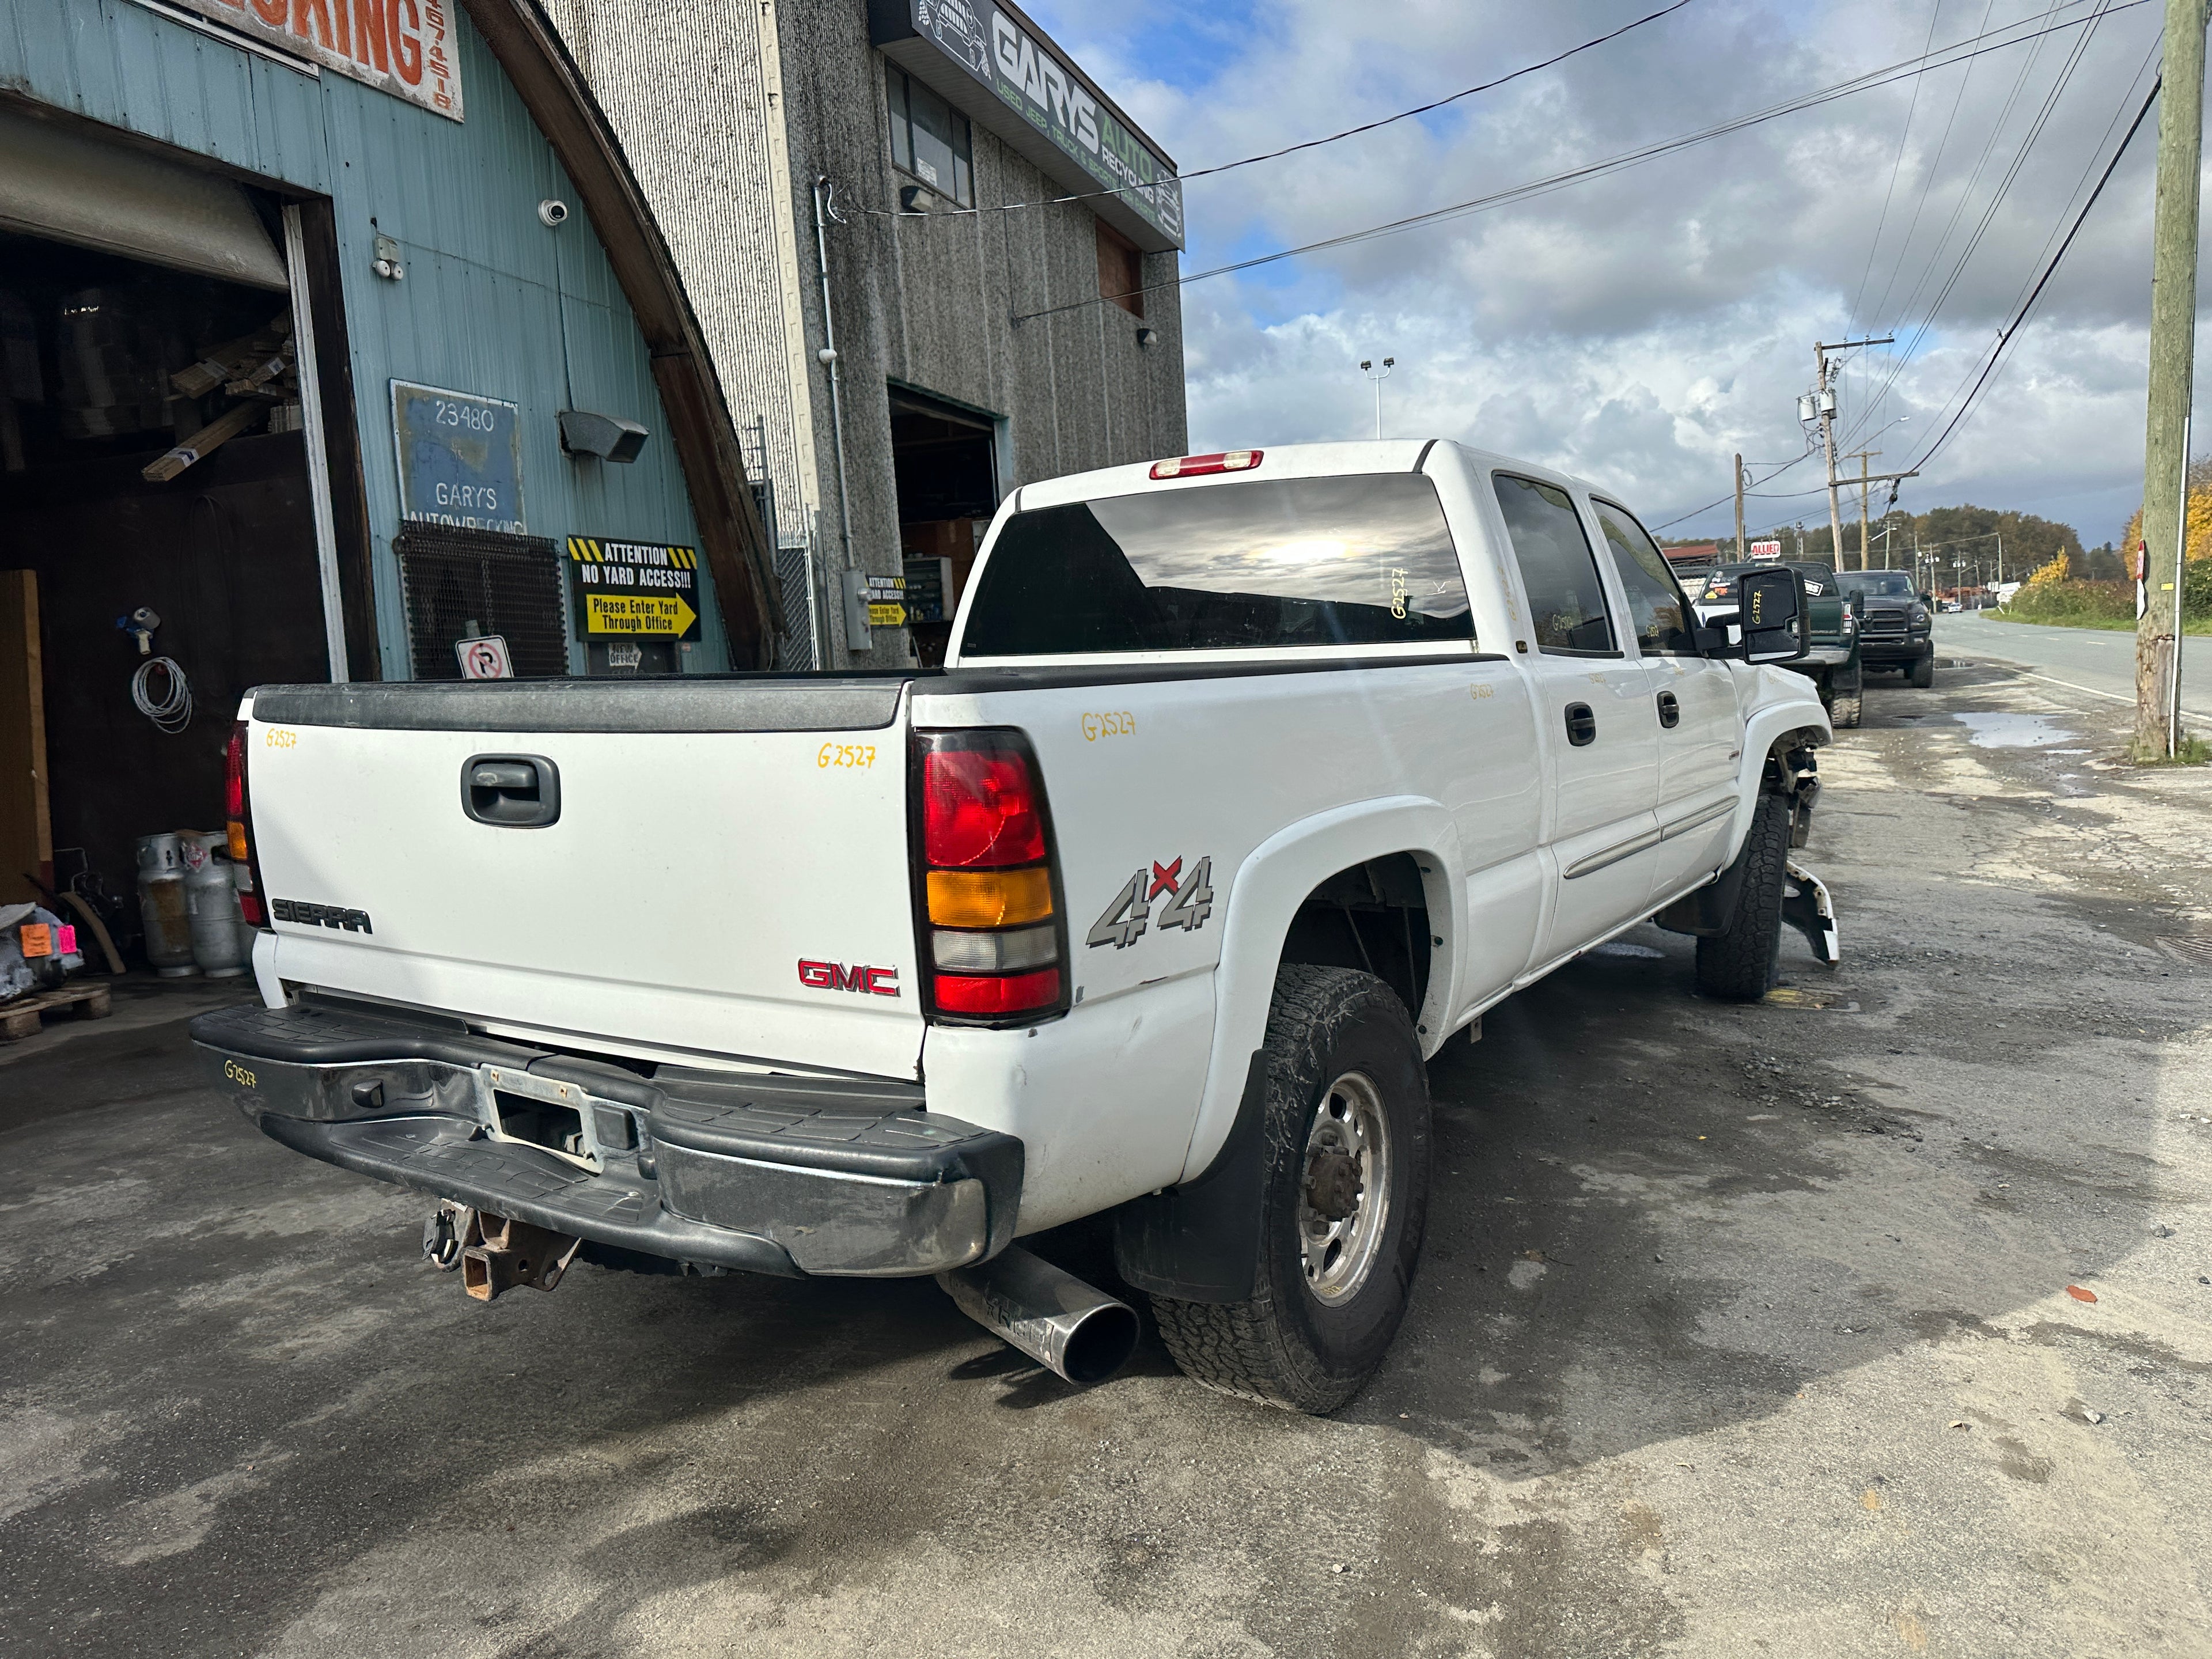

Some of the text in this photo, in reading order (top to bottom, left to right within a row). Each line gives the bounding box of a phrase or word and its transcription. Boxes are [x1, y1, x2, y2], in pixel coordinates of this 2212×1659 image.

[992, 10, 1099, 154] GARYS
[996, 78, 1023, 111] USED
[1051, 124, 1079, 158] TRUCK
[1101, 115, 1152, 184] AUTO
[1101, 145, 1154, 204] RECYCLING
[436, 400, 494, 432] 23480
[436, 482, 497, 510] GARY'S
[605, 543, 668, 566] ATTENTION
[1752, 544, 1779, 554] ALLIED
[581, 564, 691, 589] NO YARD ACCESS!!!
[869, 577, 895, 588] ATTENTION
[593, 598, 679, 615] Please Enter Yard
[1391, 568, 1408, 619] G2527
[1752, 590, 1763, 624] G2527
[602, 614, 673, 632] Through Office
[610, 653, 639, 664] OFFICE
[267, 728, 296, 749] G2527
[1082, 711, 1136, 742] G2527
[817, 742, 876, 769] G2527
[272, 898, 373, 934] SIERRA
[798, 957, 902, 997] GMC
[224, 1059, 257, 1089] G2527
